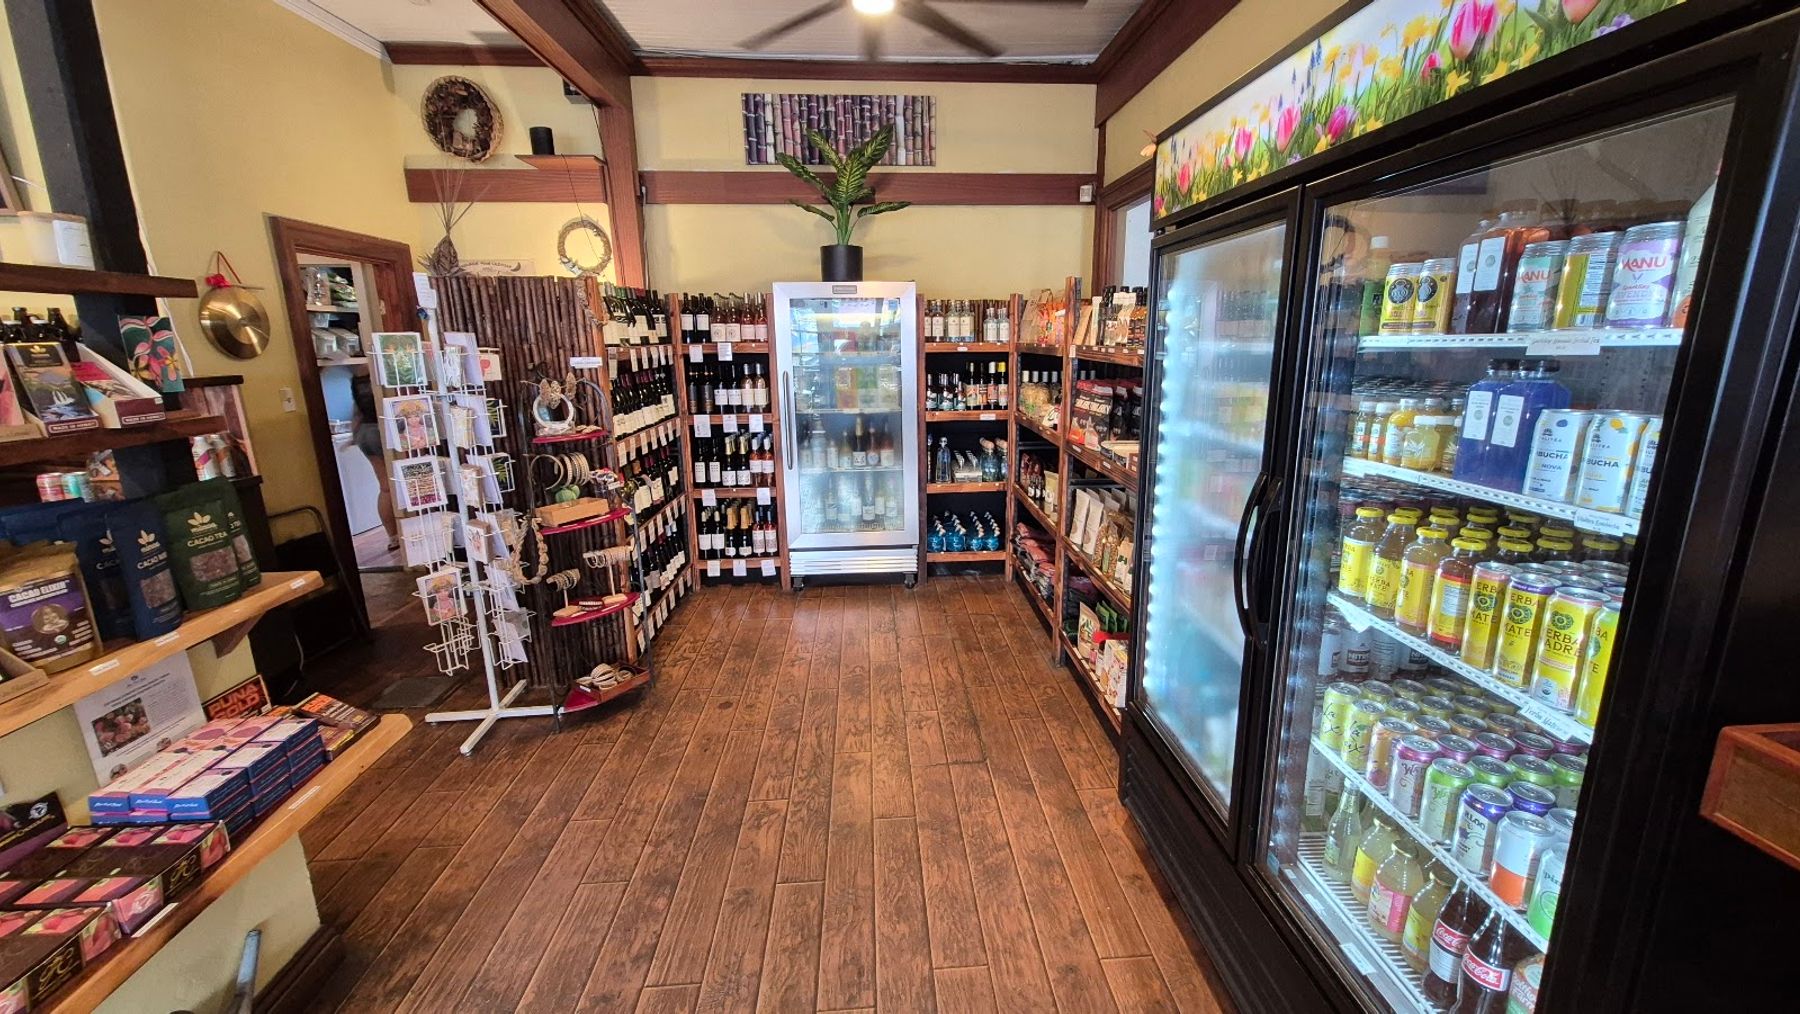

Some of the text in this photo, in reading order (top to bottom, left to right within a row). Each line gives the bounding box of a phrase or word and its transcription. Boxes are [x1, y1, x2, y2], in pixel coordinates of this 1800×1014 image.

[1537, 451, 1569, 460] BUCHA
[1586, 457, 1619, 468] BUCHA
[187, 535, 214, 547] CACAO
[1477, 581, 1504, 595] ERBA
[8, 588, 41, 604] CACAO
[1511, 593, 1540, 607] ERBA
[1546, 628, 1579, 645] ERBA
[1545, 639, 1584, 657] ADRE
[208, 682, 259, 715] PUNA
